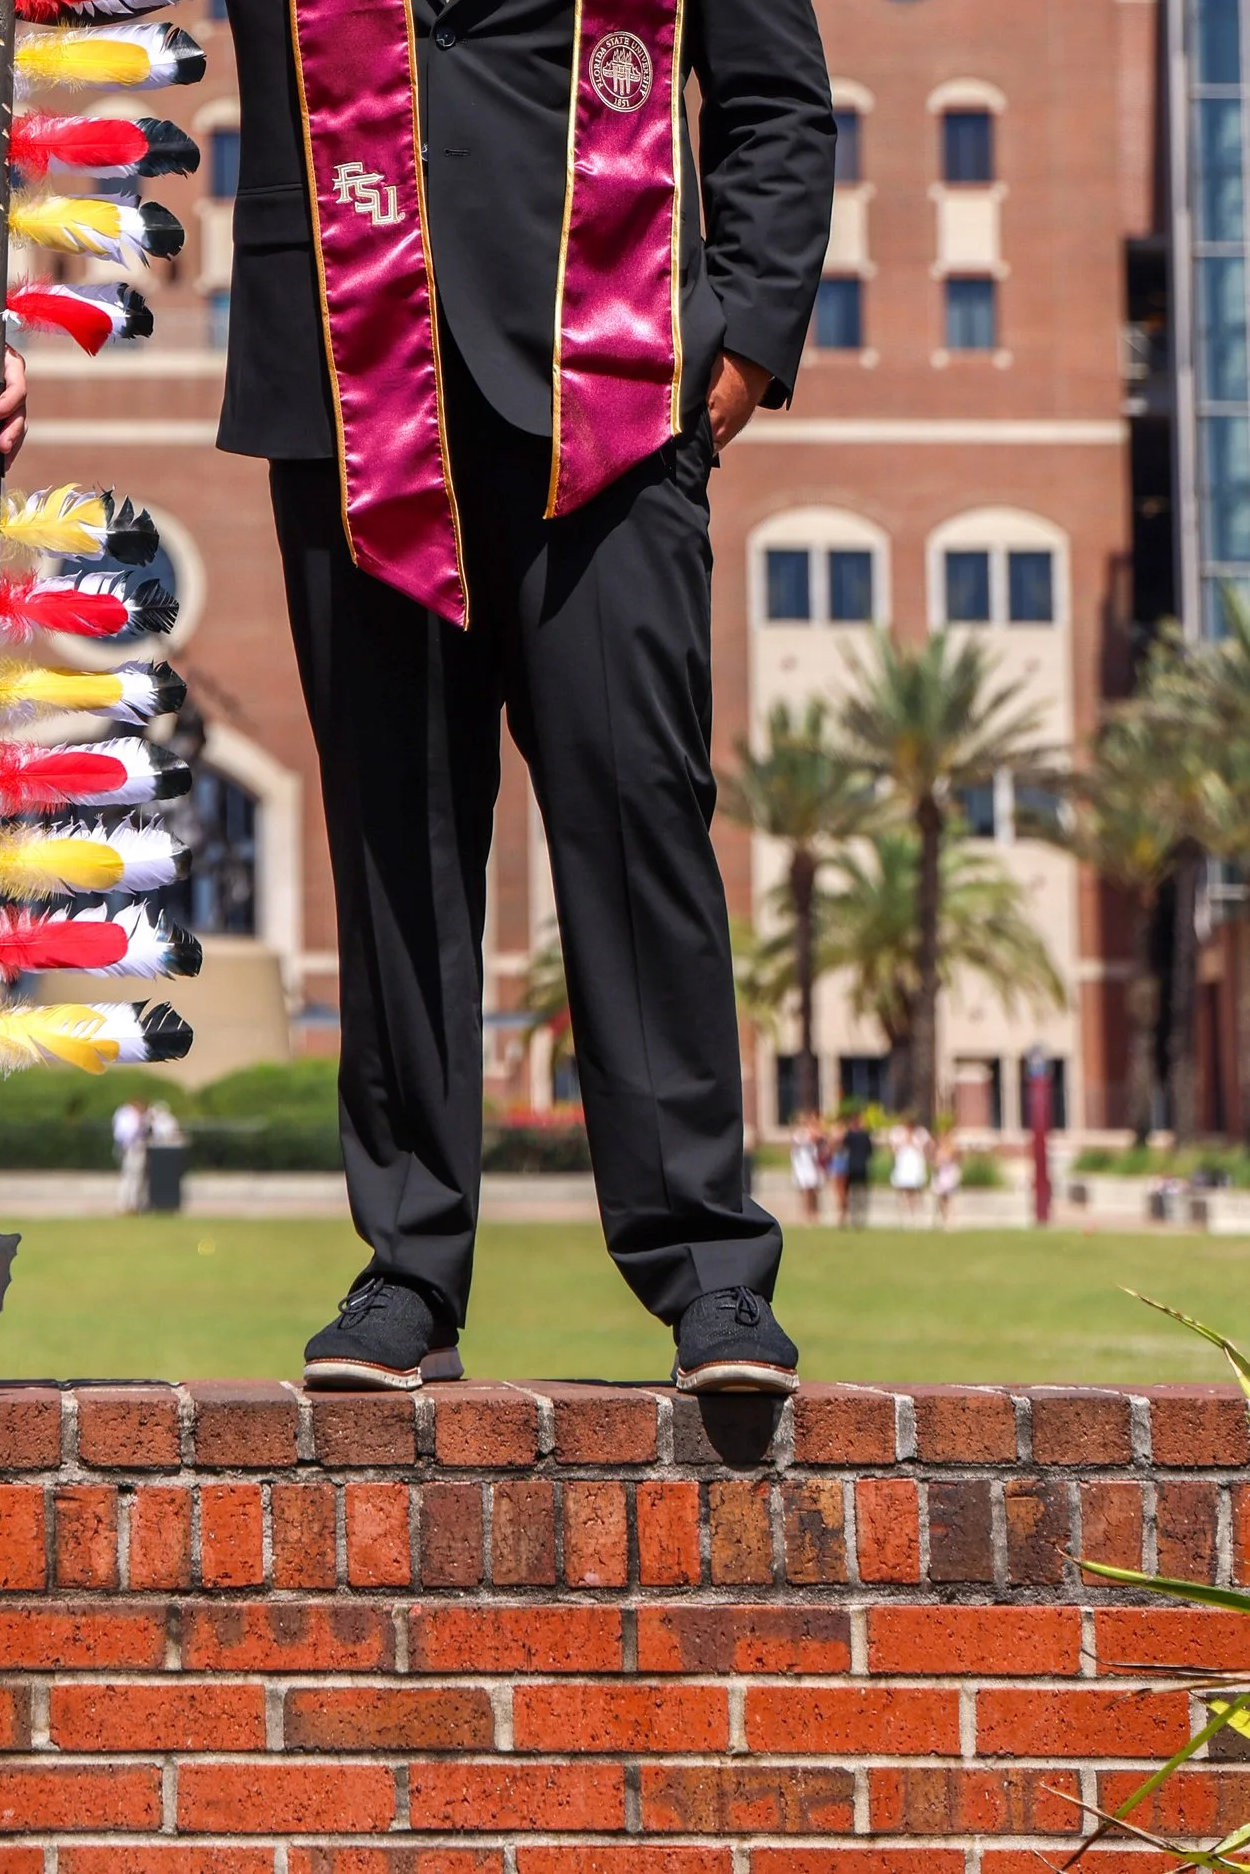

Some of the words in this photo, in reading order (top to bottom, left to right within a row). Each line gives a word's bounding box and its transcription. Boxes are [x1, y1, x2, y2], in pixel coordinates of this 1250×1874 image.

[593, 47, 607, 90] FLORIDA
[605, 36, 630, 48] STATE
[630, 41, 650, 97] UNIVERSITY
[613, 98, 630, 107] 1851
[331, 161, 399, 226] FSU
